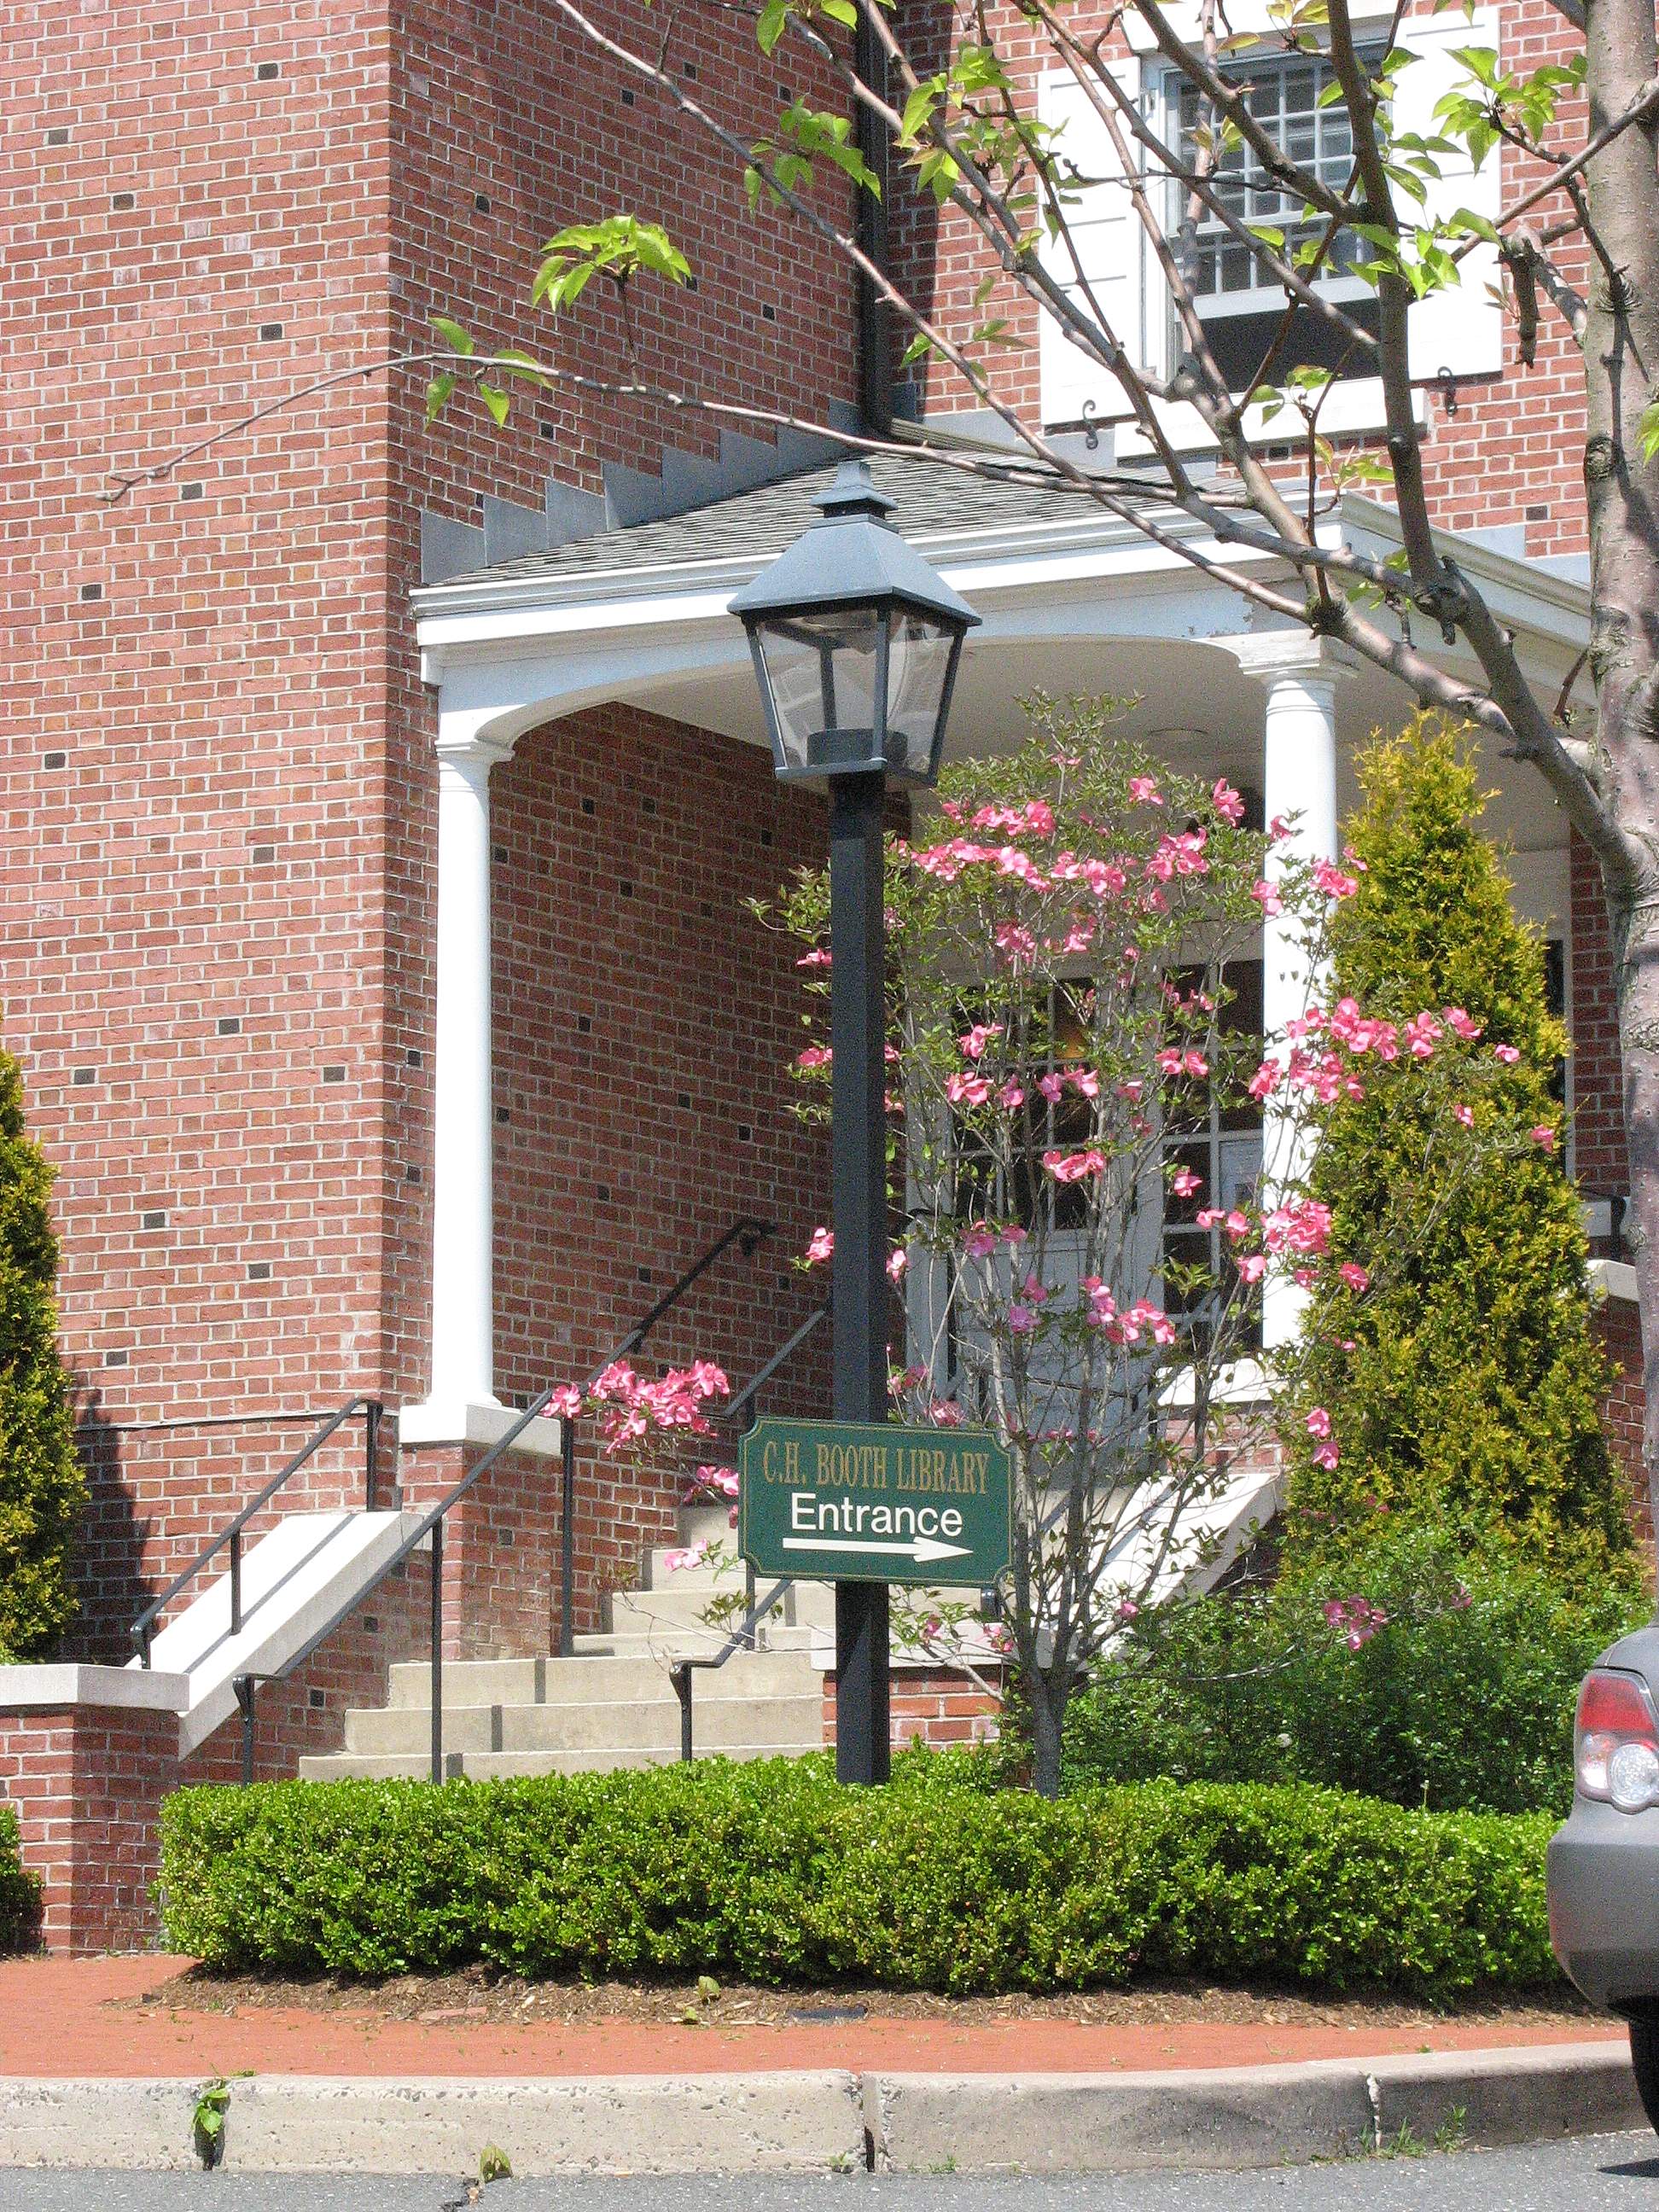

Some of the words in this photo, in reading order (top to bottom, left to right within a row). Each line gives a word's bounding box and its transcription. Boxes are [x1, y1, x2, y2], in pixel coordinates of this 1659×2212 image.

[763, 1441, 806, 1485] C.H.
[817, 1443, 888, 1489] BOOTH
[896, 1448, 992, 1494] LIBRARY
[790, 1493, 963, 1537] Entrance
